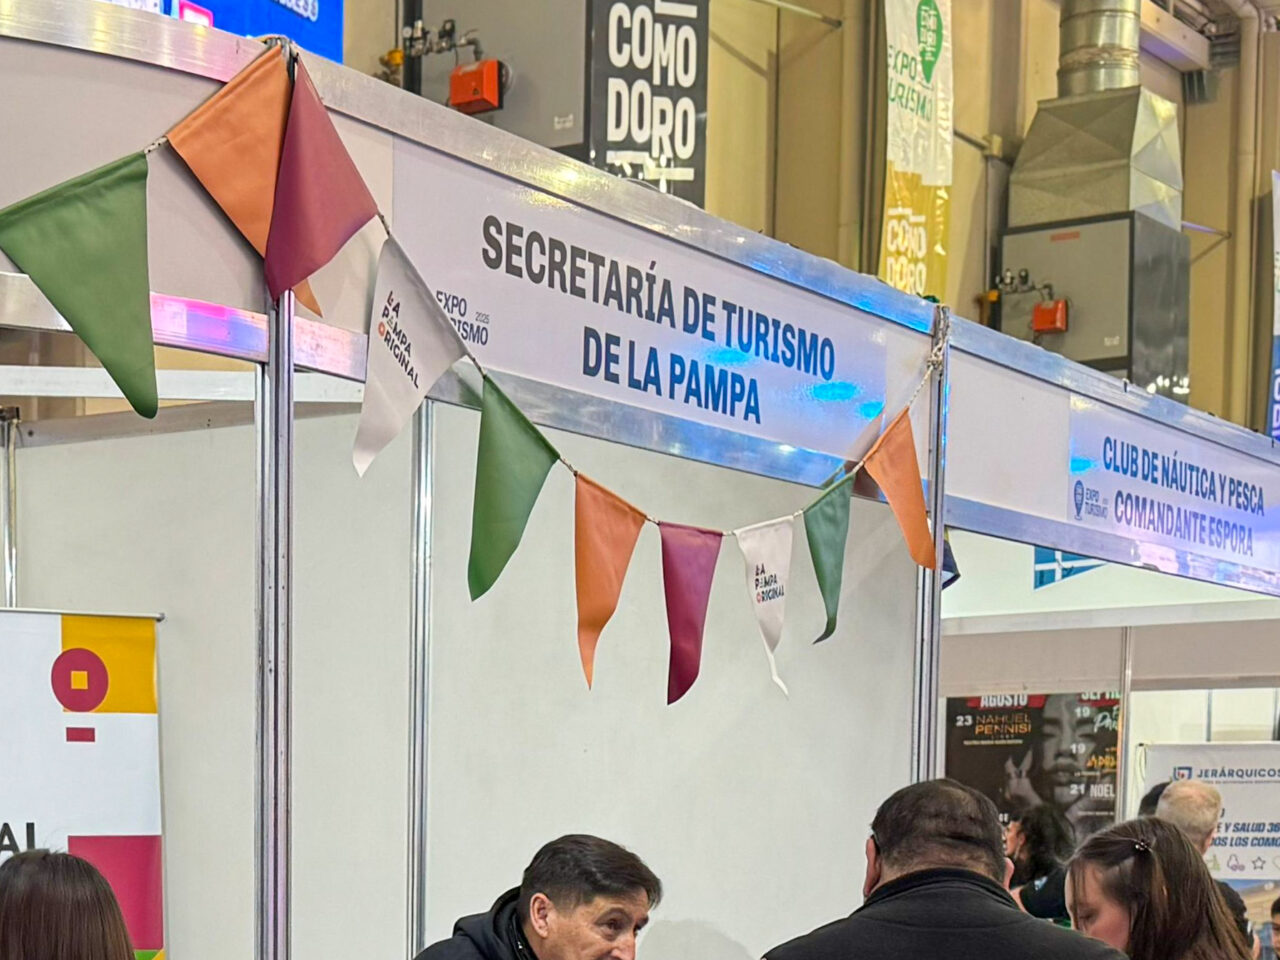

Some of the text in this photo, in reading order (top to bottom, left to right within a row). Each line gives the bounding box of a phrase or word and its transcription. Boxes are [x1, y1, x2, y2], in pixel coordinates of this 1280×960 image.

[608, 2, 698, 88] COMO
[888, 77, 934, 122] URISMO
[607, 77, 697, 160] DORO
[386, 290, 401, 319] LA
[481, 214, 836, 382] SECRETARÍA DE TURISMO
[451, 317, 489, 347] ISMO
[377, 321, 420, 390] ORIGINAL
[582, 325, 762, 425] DE LA PAMPA
[1102, 436, 1266, 517] CLUB DE NÁUTICA Y PESCA
[1114, 489, 1254, 557] COMANDANTE ESPORA
[955, 713, 1032, 728] 23 NAHUEL
[1075, 706, 1091, 718] 19
[975, 723, 1032, 736] PENNISI
[1070, 742, 1087, 755] 19
[1197, 766, 1280, 779] JERÁRQUICOS
[1070, 783, 1116, 798] 21 NOEL
[1229, 836, 1249, 847] LOS
[1232, 821, 1266, 833] SALUD
